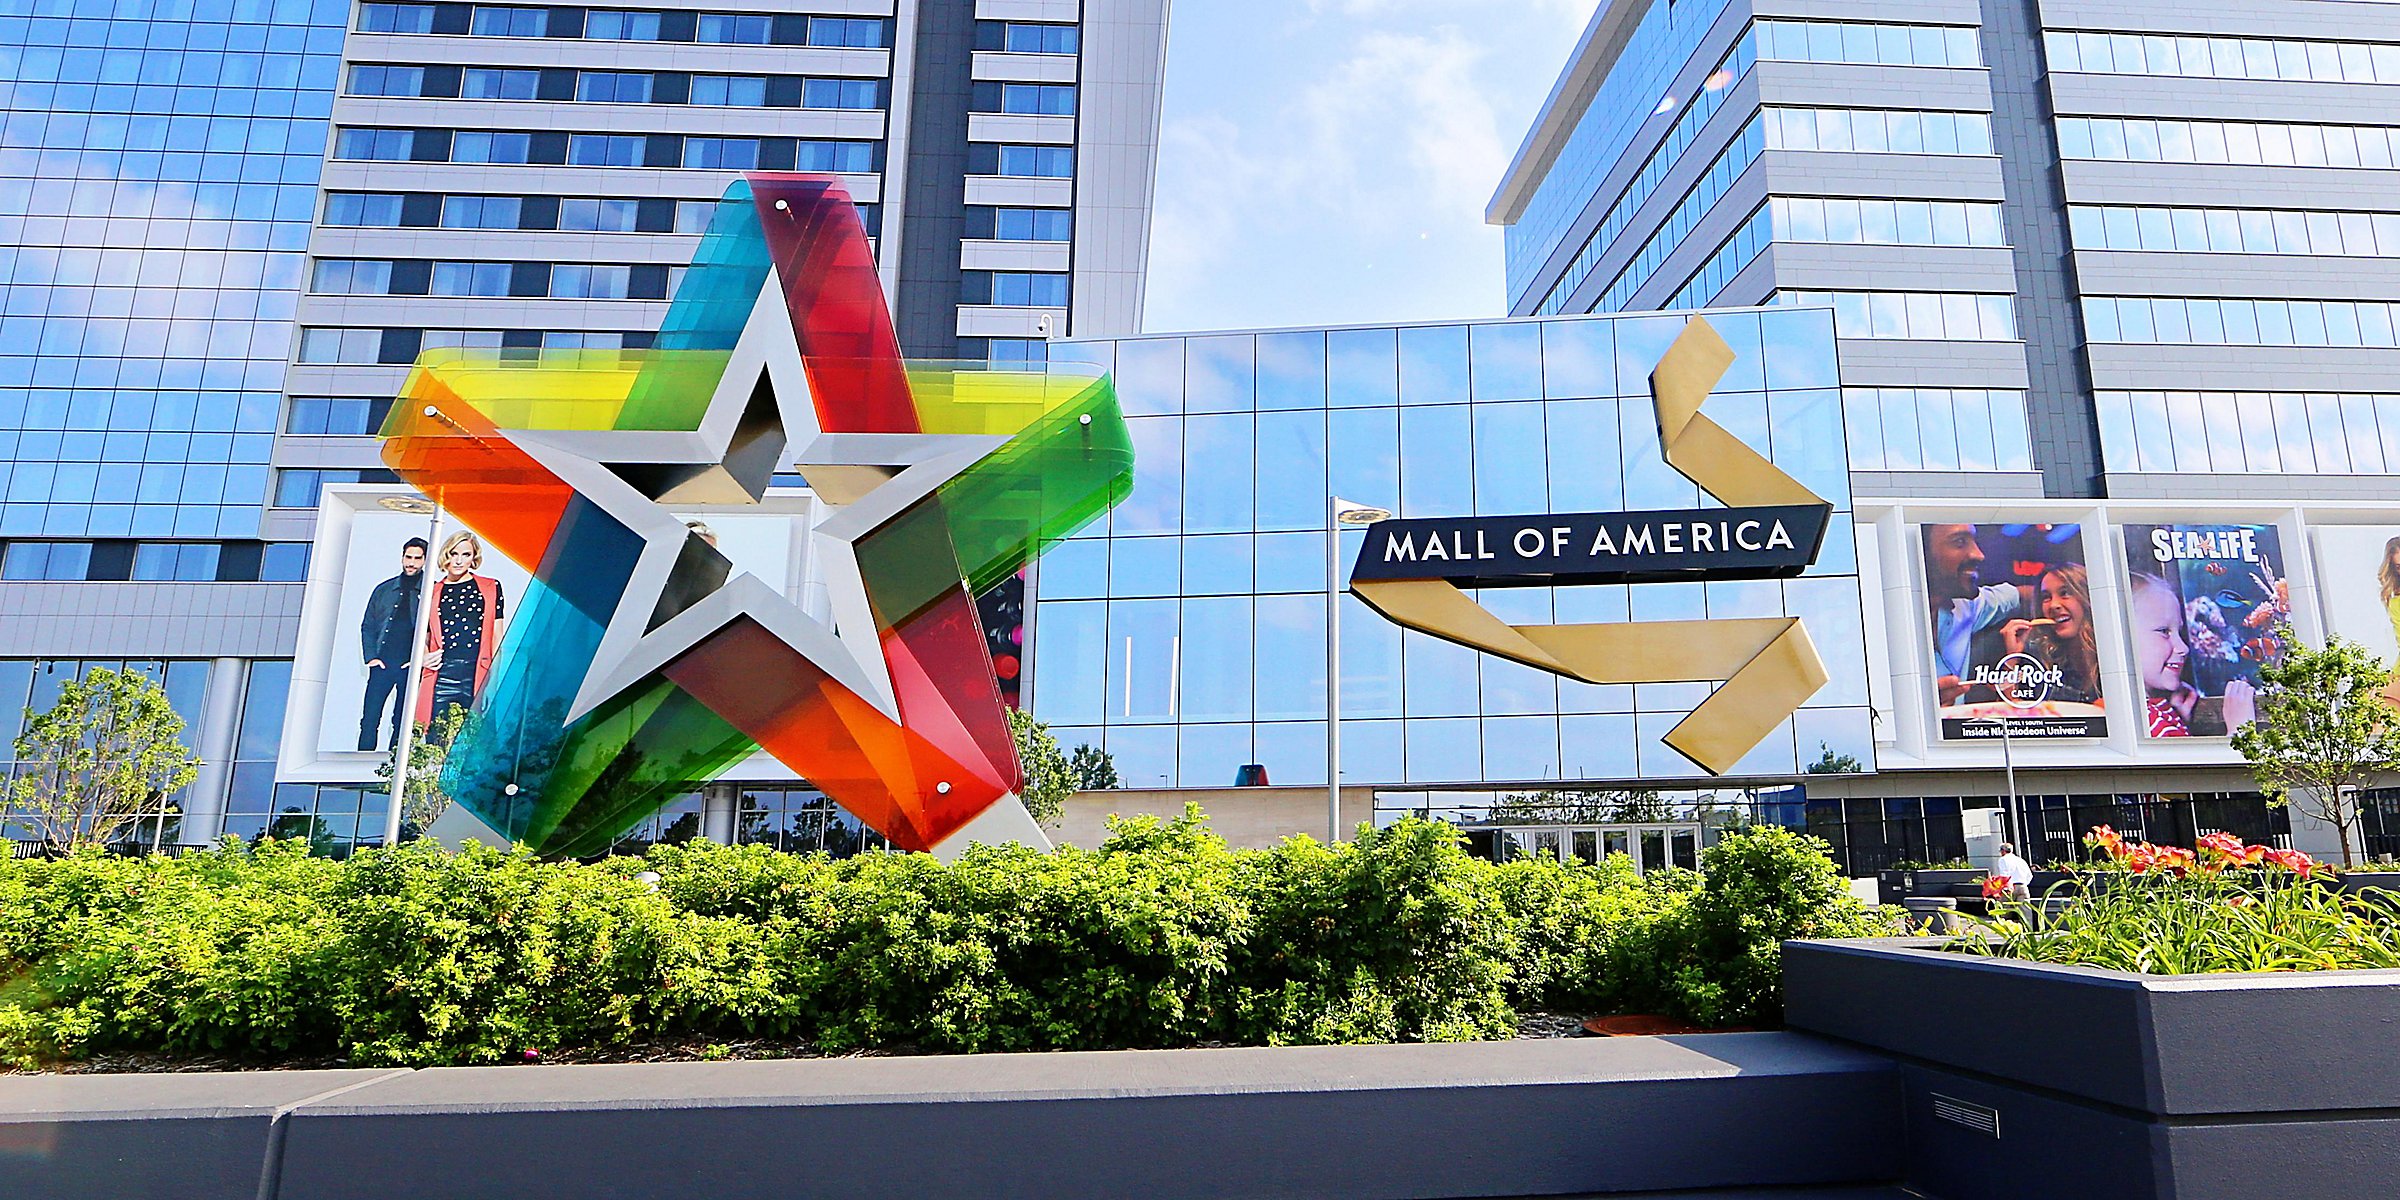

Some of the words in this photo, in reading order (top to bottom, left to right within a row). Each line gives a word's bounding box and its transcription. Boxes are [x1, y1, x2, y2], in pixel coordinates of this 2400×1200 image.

[1384, 529, 1495, 563] MALL
[1513, 527, 1571, 558] OF
[1589, 518, 1795, 557] AMERICA
[1974, 664, 2019, 684] Hard
[2020, 664, 2064, 687] Rock
[2010, 689, 2035, 698] CAFE
[1962, 727, 1989, 737] Inside
